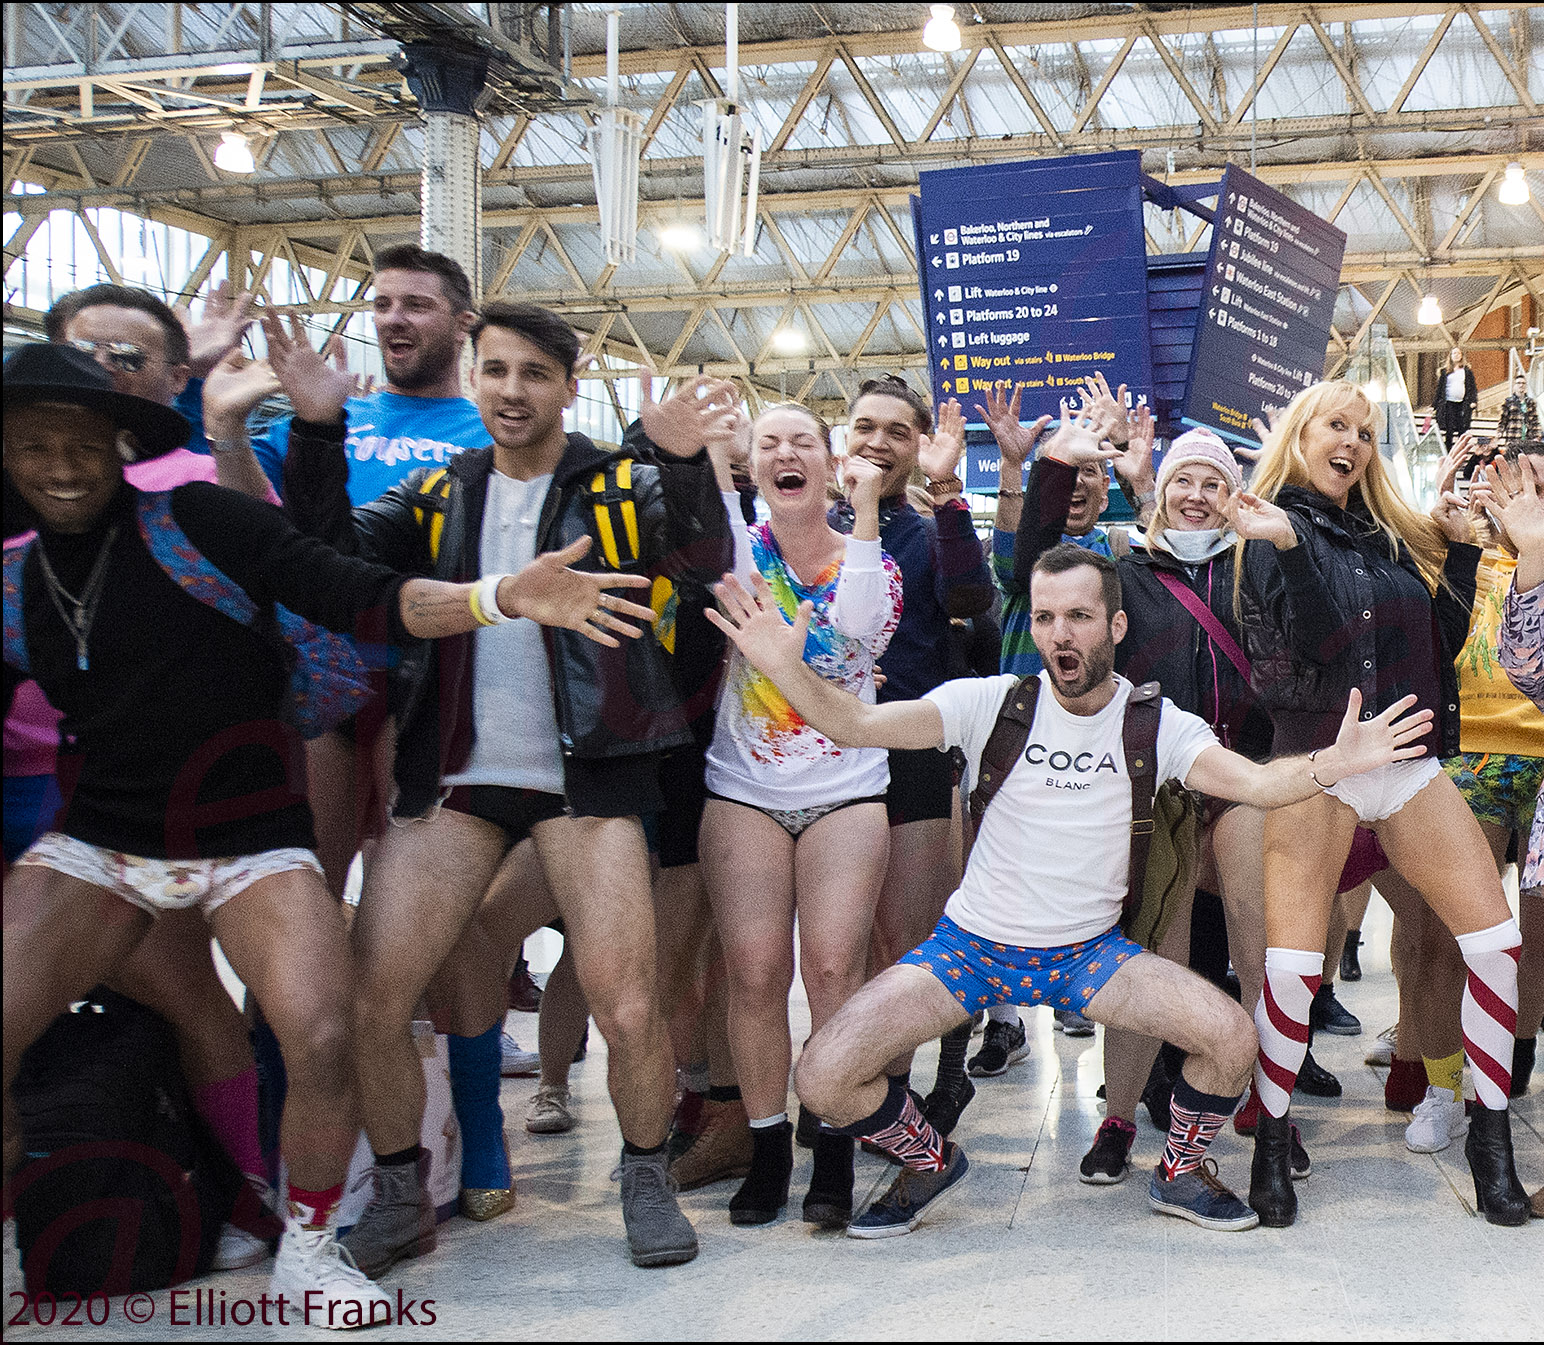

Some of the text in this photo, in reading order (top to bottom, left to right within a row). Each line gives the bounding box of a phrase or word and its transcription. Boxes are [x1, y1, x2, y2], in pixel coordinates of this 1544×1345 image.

[960, 218, 1050, 236] Bakerloo, Northern and
[961, 234, 997, 246] Waterloo
[998, 232, 1005, 242] &
[1006, 231, 1023, 243] City
[1024, 229, 1044, 241] lines
[1244, 226, 1279, 254] Platform 19
[962, 249, 1020, 266] Platform 19
[1262, 260, 1273, 275] line
[965, 285, 1048, 299] Lift Waterloo & City line
[1236, 271, 1298, 311] Waterloo East Station
[1231, 293, 1243, 308] Lift
[966, 304, 1058, 322] Platforms 20 to 24
[968, 331, 1030, 345] Left luggage
[1227, 316, 1257, 338] Platforms
[1262, 333, 1269, 344] to
[1269, 335, 1278, 348] 18
[970, 356, 992, 370] Way
[993, 355, 1011, 367] out
[1025, 356, 1043, 364] stairs
[1063, 353, 1092, 361] Waterloo
[1093, 352, 1115, 361] Bridge
[972, 379, 993, 391] Way
[1064, 376, 1084, 386] South
[1293, 369, 1303, 382] Lift
[1248, 372, 1276, 393] Platforms
[1276, 384, 1284, 397] 20
[1284, 388, 1292, 399] to
[978, 458, 1031, 472] Wele
[1025, 743, 1118, 774] COCA
[1045, 777, 1091, 791] BLANC
